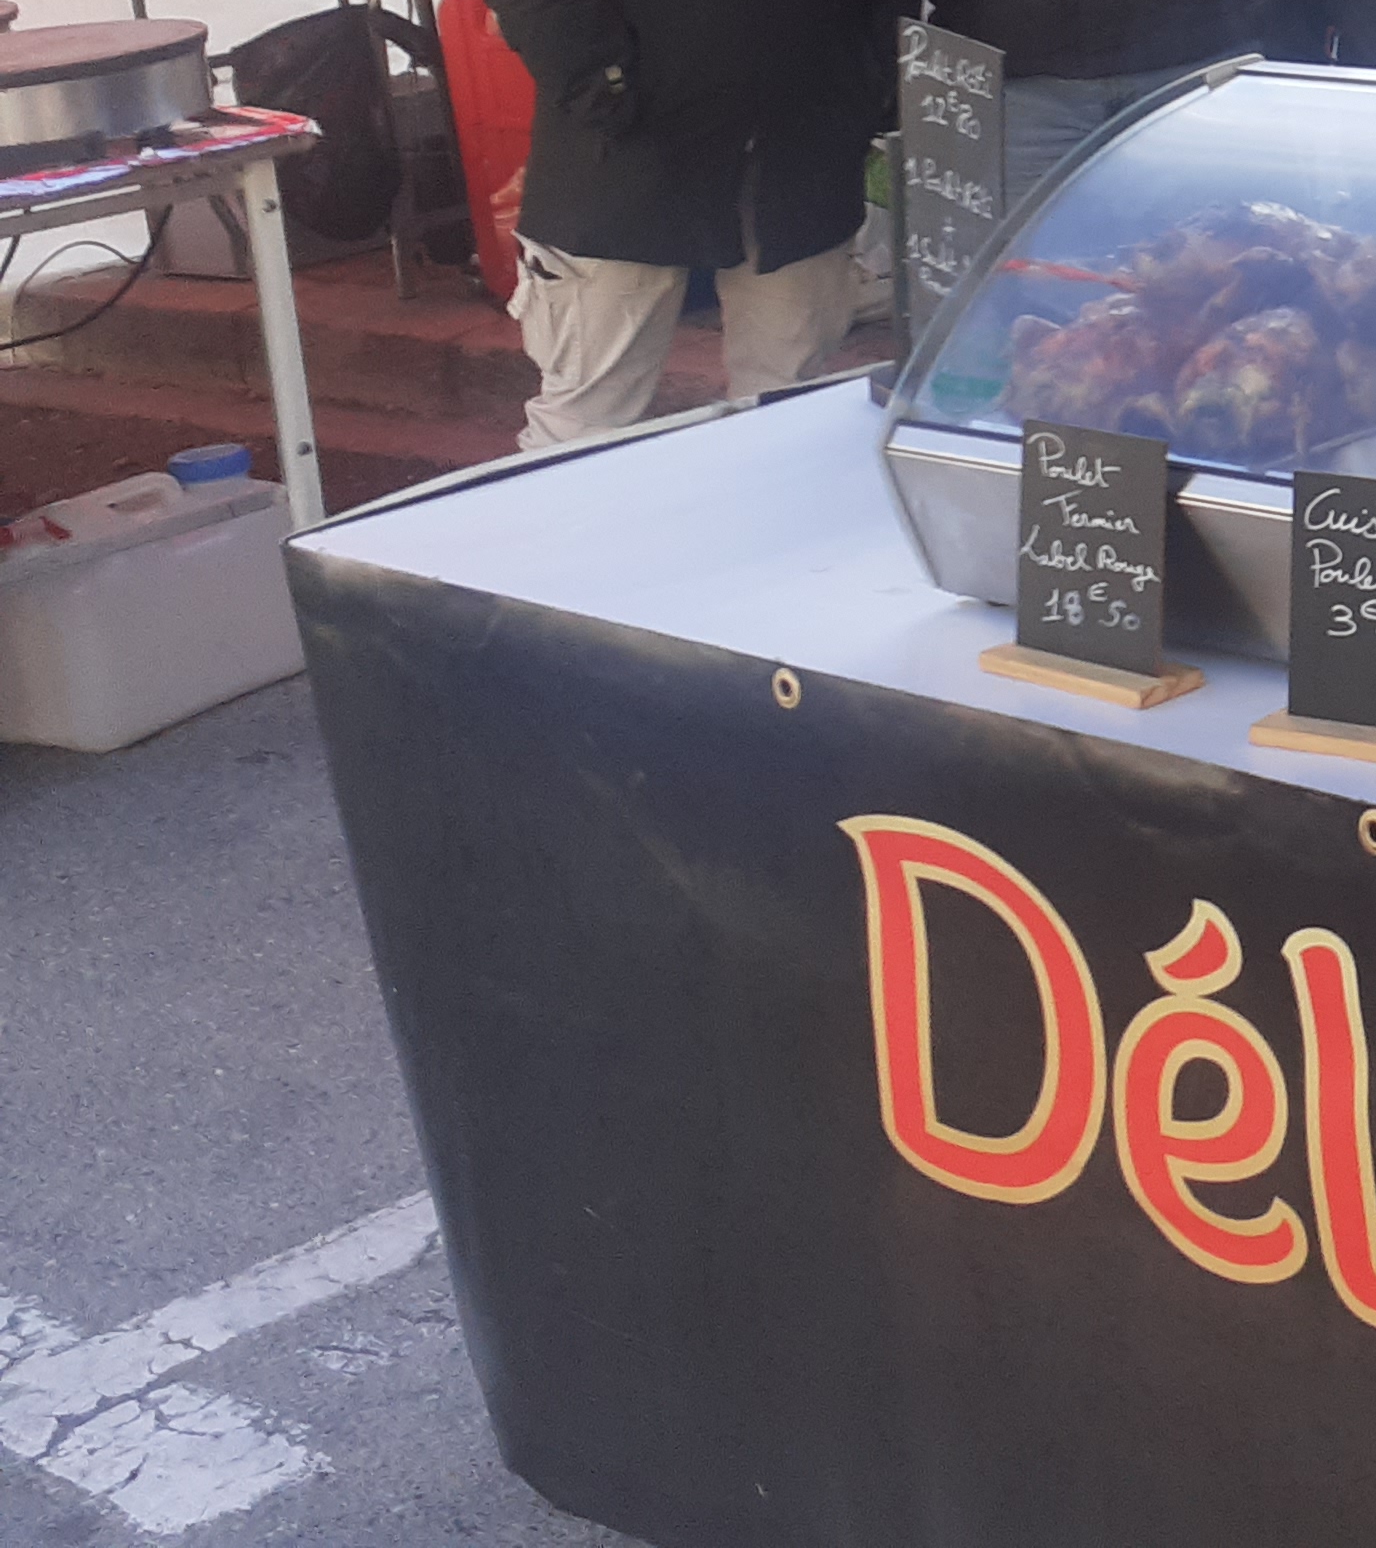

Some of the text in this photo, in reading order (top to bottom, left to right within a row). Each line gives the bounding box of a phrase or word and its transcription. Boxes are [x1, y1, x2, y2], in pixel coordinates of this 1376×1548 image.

[1026, 432, 1121, 488] Poulet
[1042, 490, 1140, 534] Fermier
[1020, 525, 1162, 592] Label Rouge
